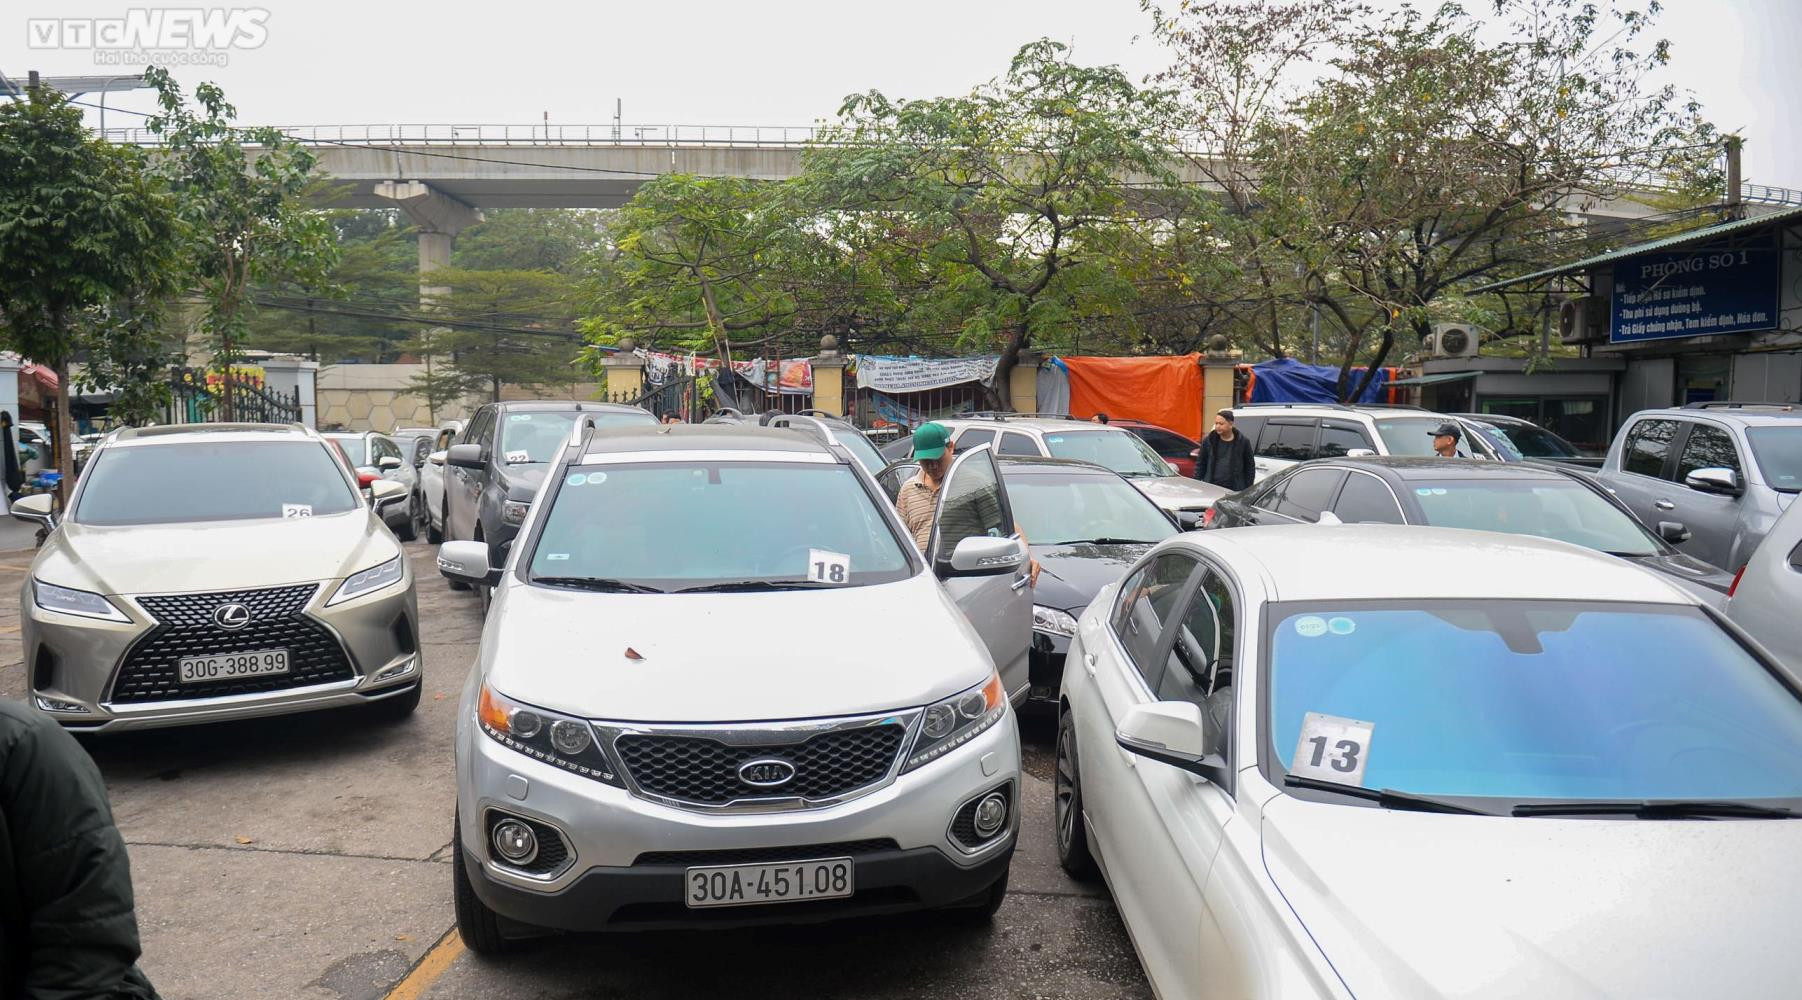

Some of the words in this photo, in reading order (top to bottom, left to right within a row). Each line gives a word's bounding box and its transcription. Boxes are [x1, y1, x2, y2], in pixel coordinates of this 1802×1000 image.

[1738, 250, 1749, 265] 1
[287, 508, 311, 519] 26
[814, 561, 845, 583] 18
[183, 653, 287, 680] 30G-388.99
[1309, 735, 1361, 773] 13
[749, 765, 786, 782] KIA
[692, 863, 848, 902] 30A-451.08
